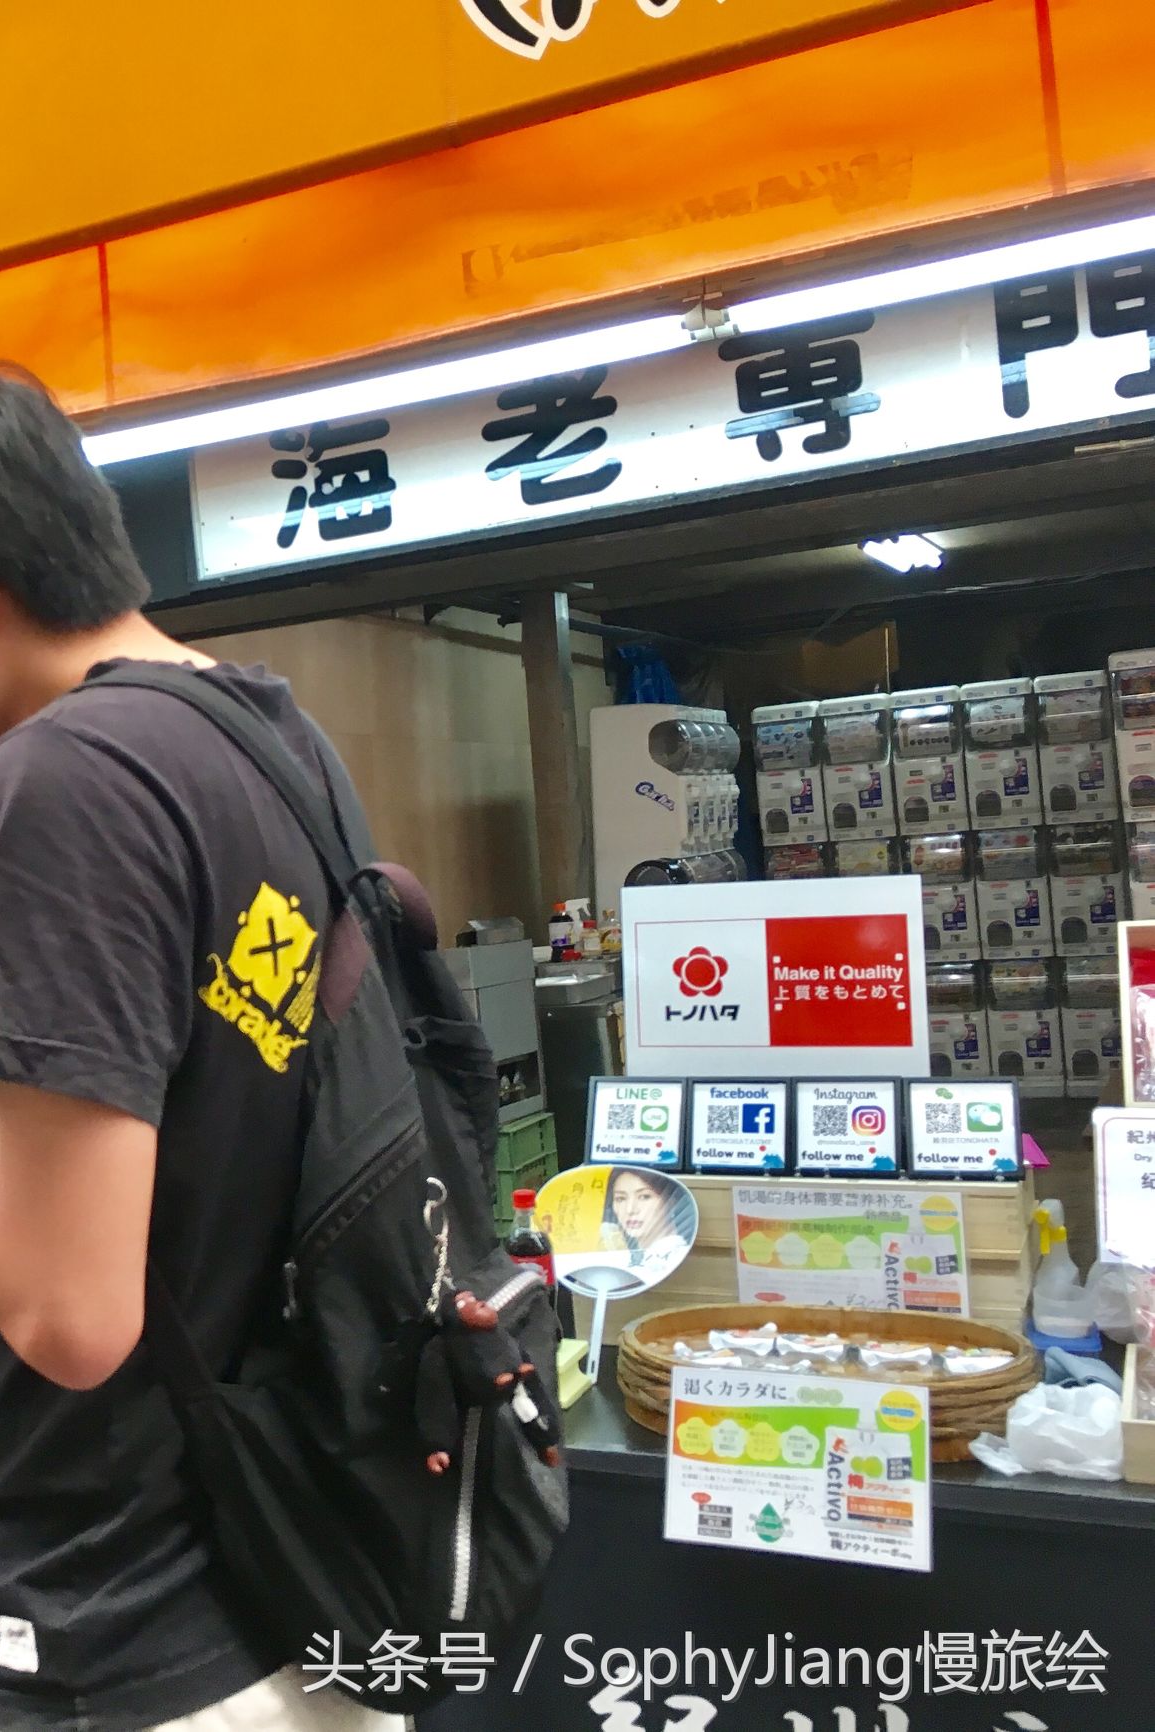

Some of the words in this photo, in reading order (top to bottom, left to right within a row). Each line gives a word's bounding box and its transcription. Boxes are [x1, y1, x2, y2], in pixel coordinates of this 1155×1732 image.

[270, 256, 1155, 549] 海老専門
[773, 966, 820, 981] Make
[824, 965, 836, 980] it
[839, 964, 904, 983] Quality
[773, 984, 906, 1001] 上質をもとめて
[665, 1004, 740, 1021] トノハタ
[616, 1087, 663, 1101] LINE@
[710, 1087, 769, 1100] facebook
[813, 1087, 879, 1104] Instagram
[596, 1143, 631, 1155] follow
[634, 1146, 651, 1155] me
[696, 1147, 734, 1159] follow
[737, 1149, 755, 1159] me
[801, 1149, 842, 1161] follow
[845, 1152, 864, 1162] me
[917, 1152, 960, 1164] follow
[963, 1154, 983, 1164] me
[1134, 1153, 1153, 1164] Dry
[826, 1451, 845, 1523] Activo
